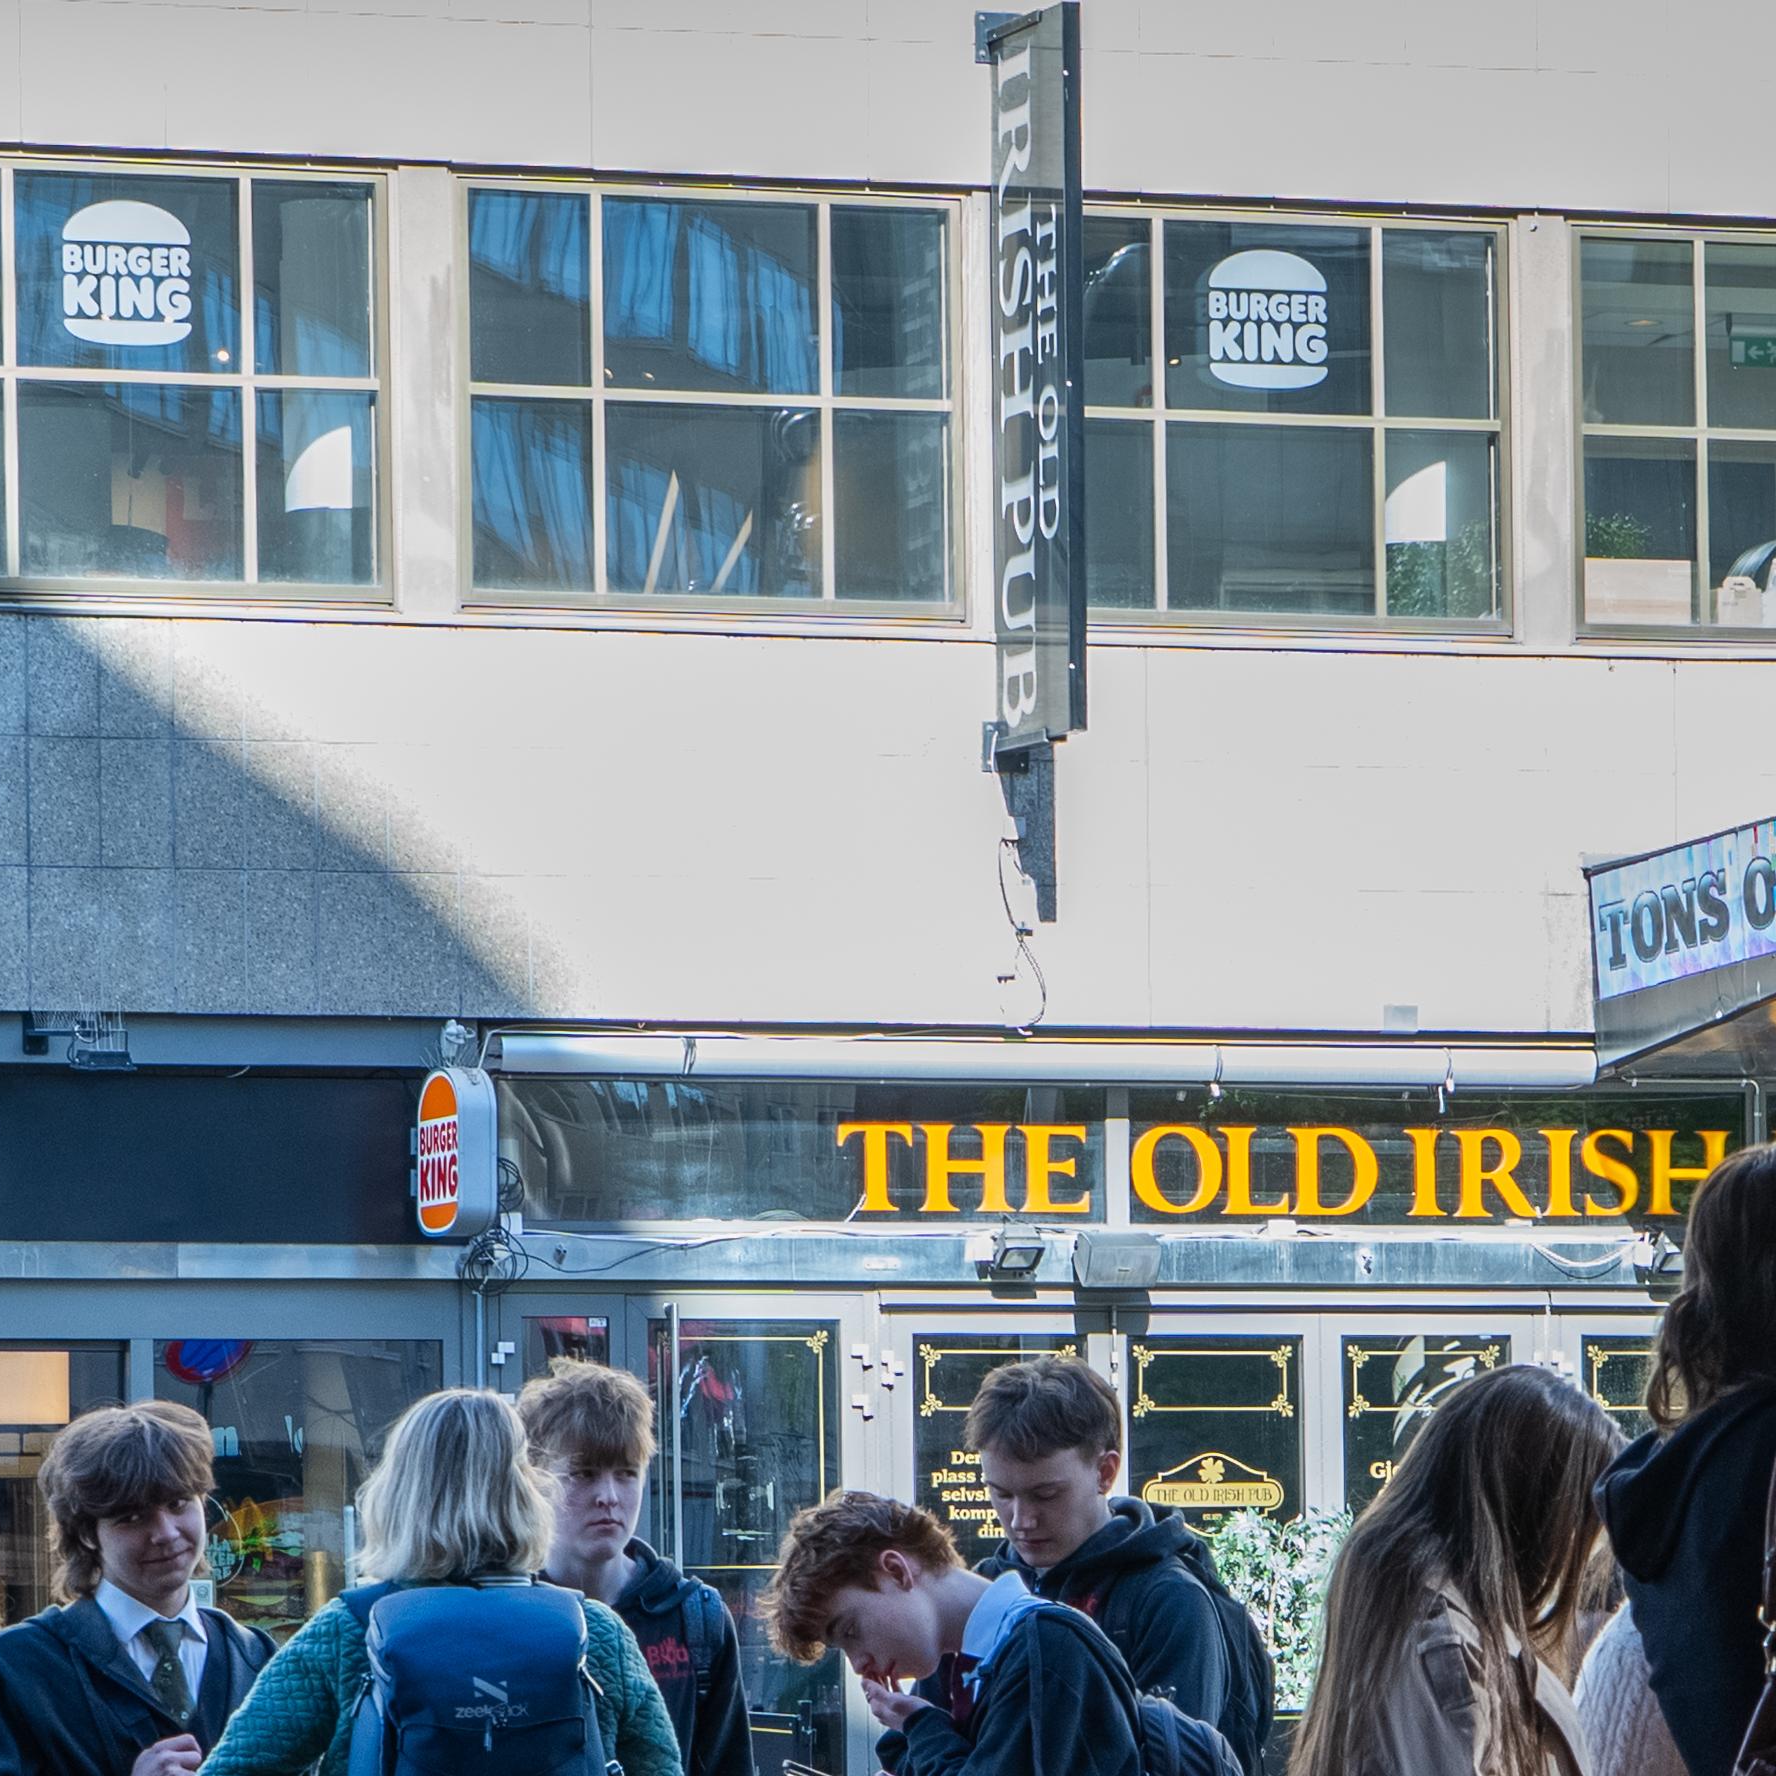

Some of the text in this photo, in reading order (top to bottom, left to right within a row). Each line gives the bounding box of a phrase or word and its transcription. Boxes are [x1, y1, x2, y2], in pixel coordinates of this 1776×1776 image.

[62, 243, 192, 277] BURGER
[63, 274, 193, 320] KING
[1208, 290, 1328, 323] BURGER
[1209, 319, 1329, 364] KING
[998, 41, 1037, 727] IRISH PUB
[1037, 203, 1060, 540] THE OLD
[1599, 866, 1729, 970] TONS
[419, 1120, 458, 1157] BURGER
[420, 1153, 458, 1202] KING
[837, 1123, 1091, 1214] THE
[1131, 1125, 1379, 1217] OLD
[1403, 1127, 1731, 1217] IRISH
[931, 1468, 977, 1488] plass
[1154, 1487, 1272, 1504] THE OLD IRISH PUB
[948, 1505, 1000, 1525] komp
